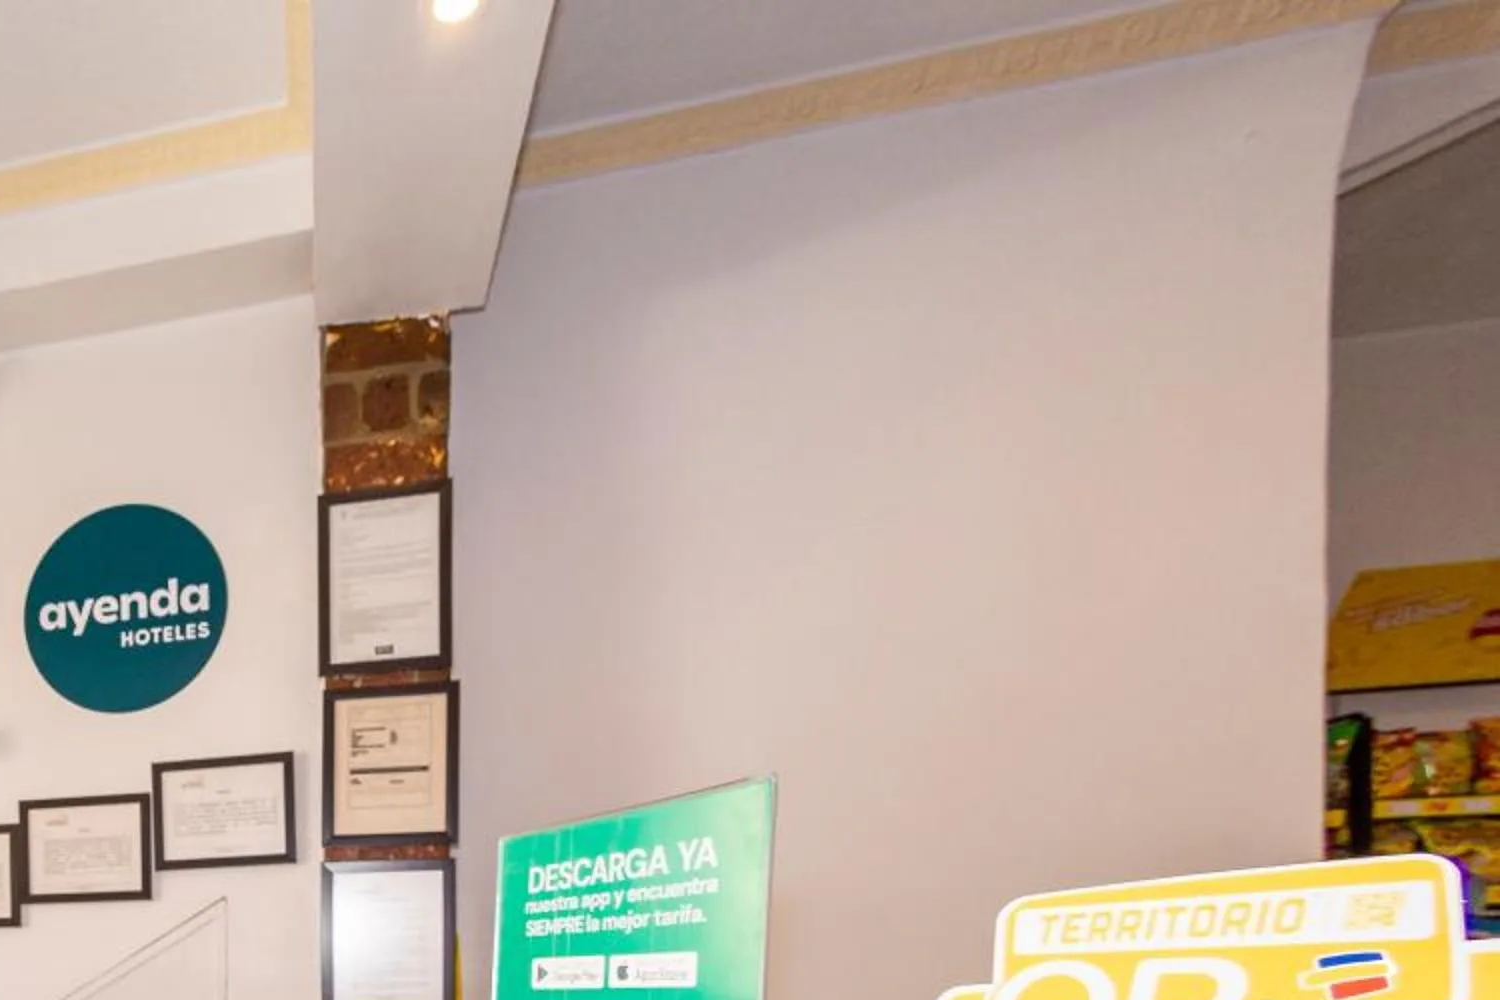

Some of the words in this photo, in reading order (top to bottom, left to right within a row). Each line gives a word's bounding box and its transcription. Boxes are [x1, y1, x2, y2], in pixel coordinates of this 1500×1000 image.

[38, 577, 210, 637] ayenda
[120, 622, 211, 648] HOTELES
[529, 846, 671, 894] DESCARGA
[678, 837, 718, 872] YA
[525, 895, 579, 915] nuestra
[581, 892, 611, 913] app
[614, 888, 625, 909] y
[627, 877, 719, 902] encuentra
[525, 914, 584, 938] SIEMPRE
[586, 913, 601, 933] la
[602, 909, 650, 935] mejor
[655, 903, 708, 926] tarifa.
[1040, 898, 1304, 946] TERRITORIO
